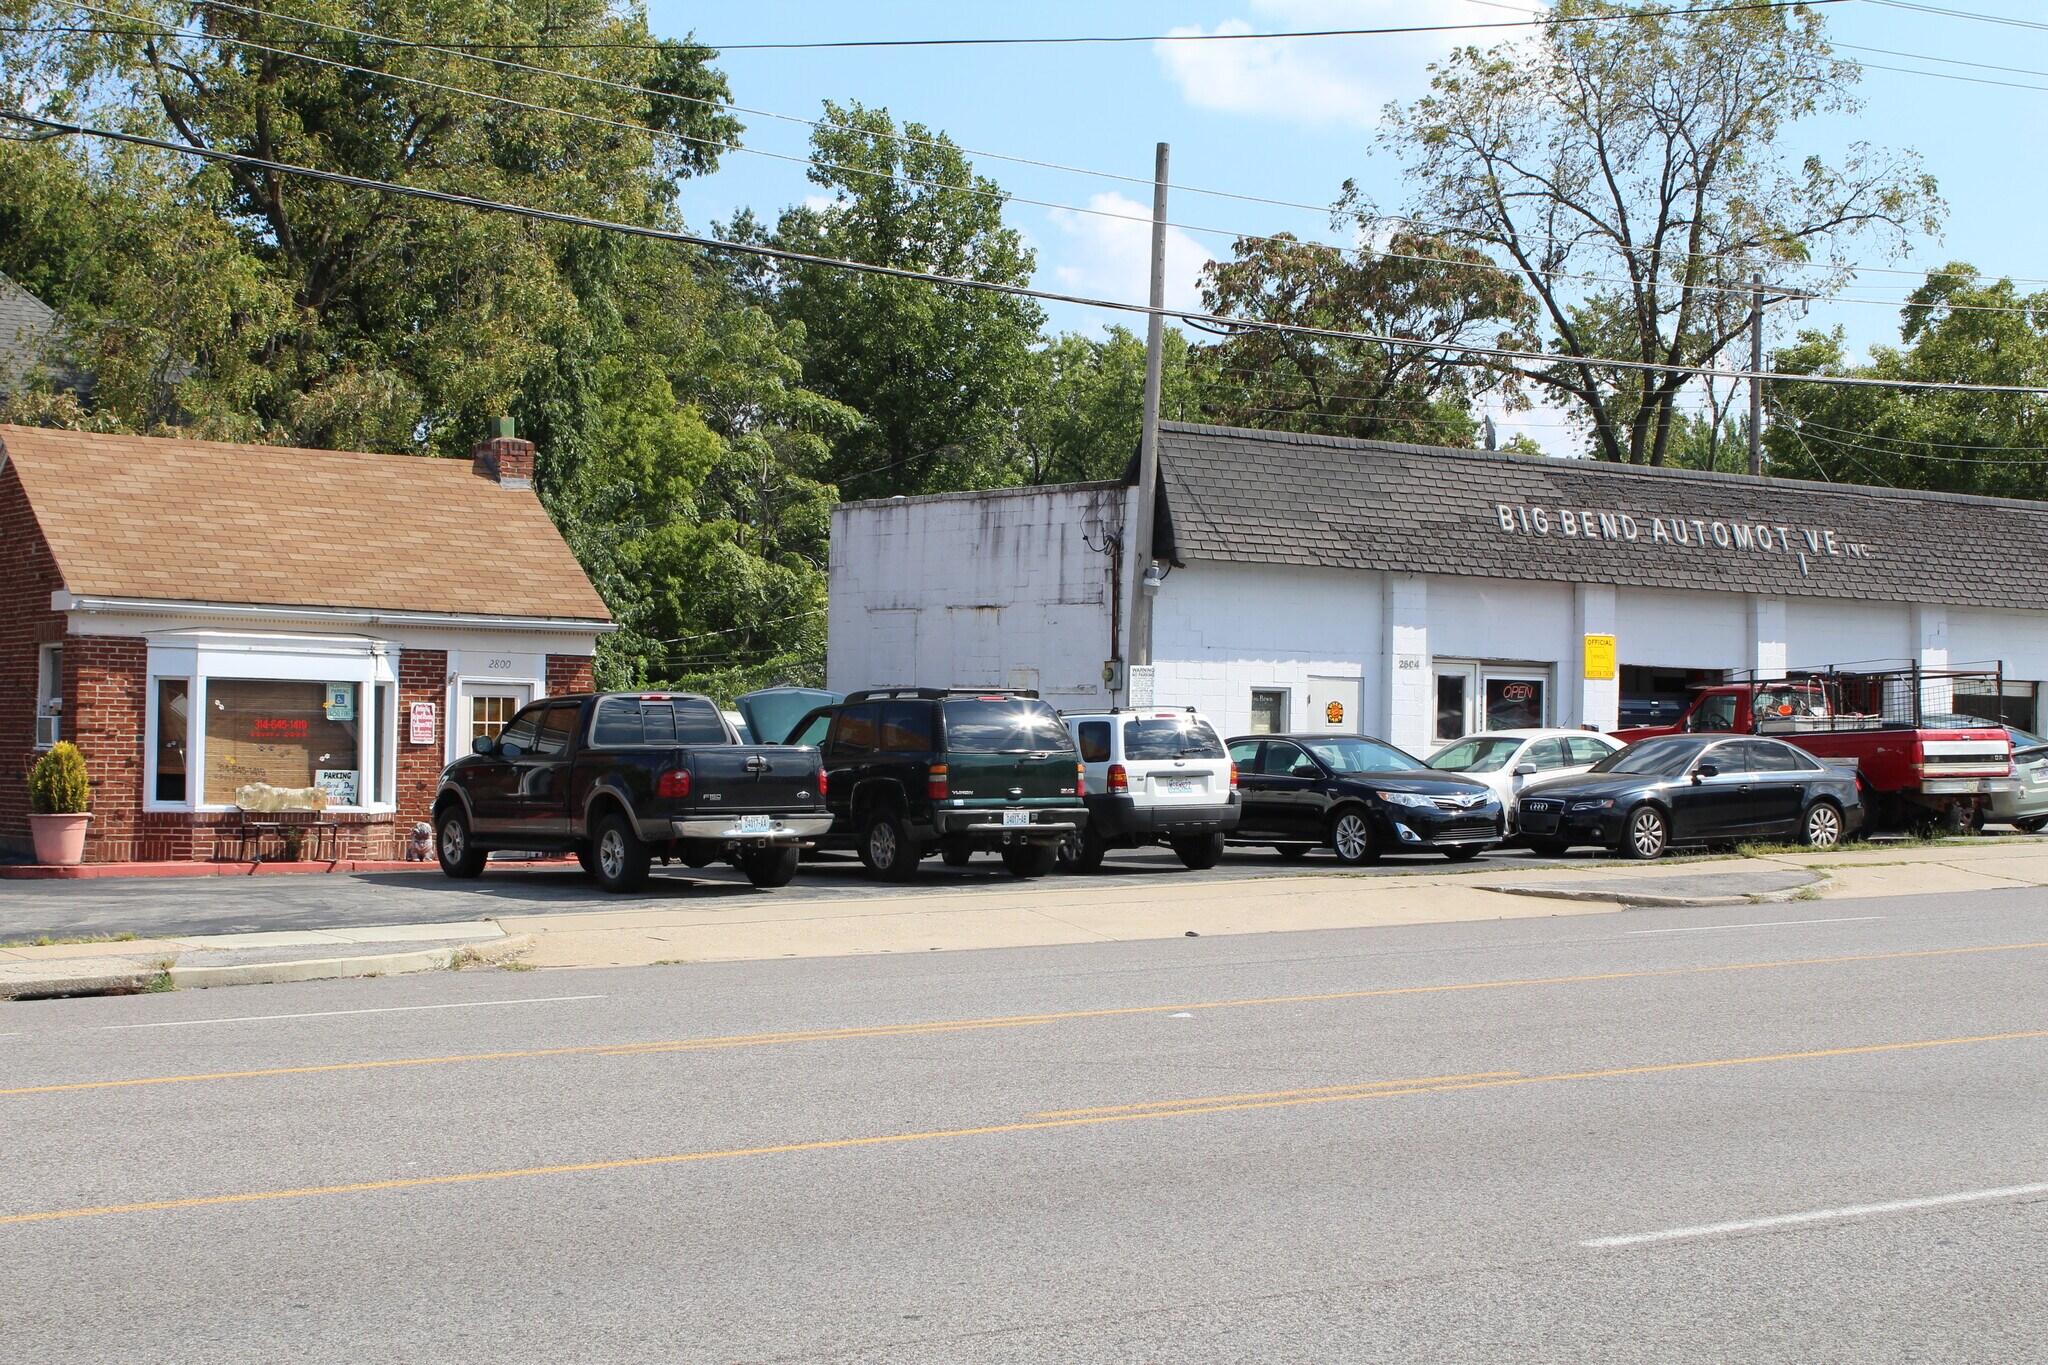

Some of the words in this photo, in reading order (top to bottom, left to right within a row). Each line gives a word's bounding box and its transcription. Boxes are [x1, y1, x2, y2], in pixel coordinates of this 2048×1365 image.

[1495, 504, 1549, 535] BIG
[1558, 509, 1637, 542] BEND
[488, 659, 512, 669] 2800
[1502, 685, 1534, 699] OPEN
[254, 719, 309, 729] 314-645-1419
[323, 771, 352, 779] PARKING
[344, 781, 355, 791] Dog
